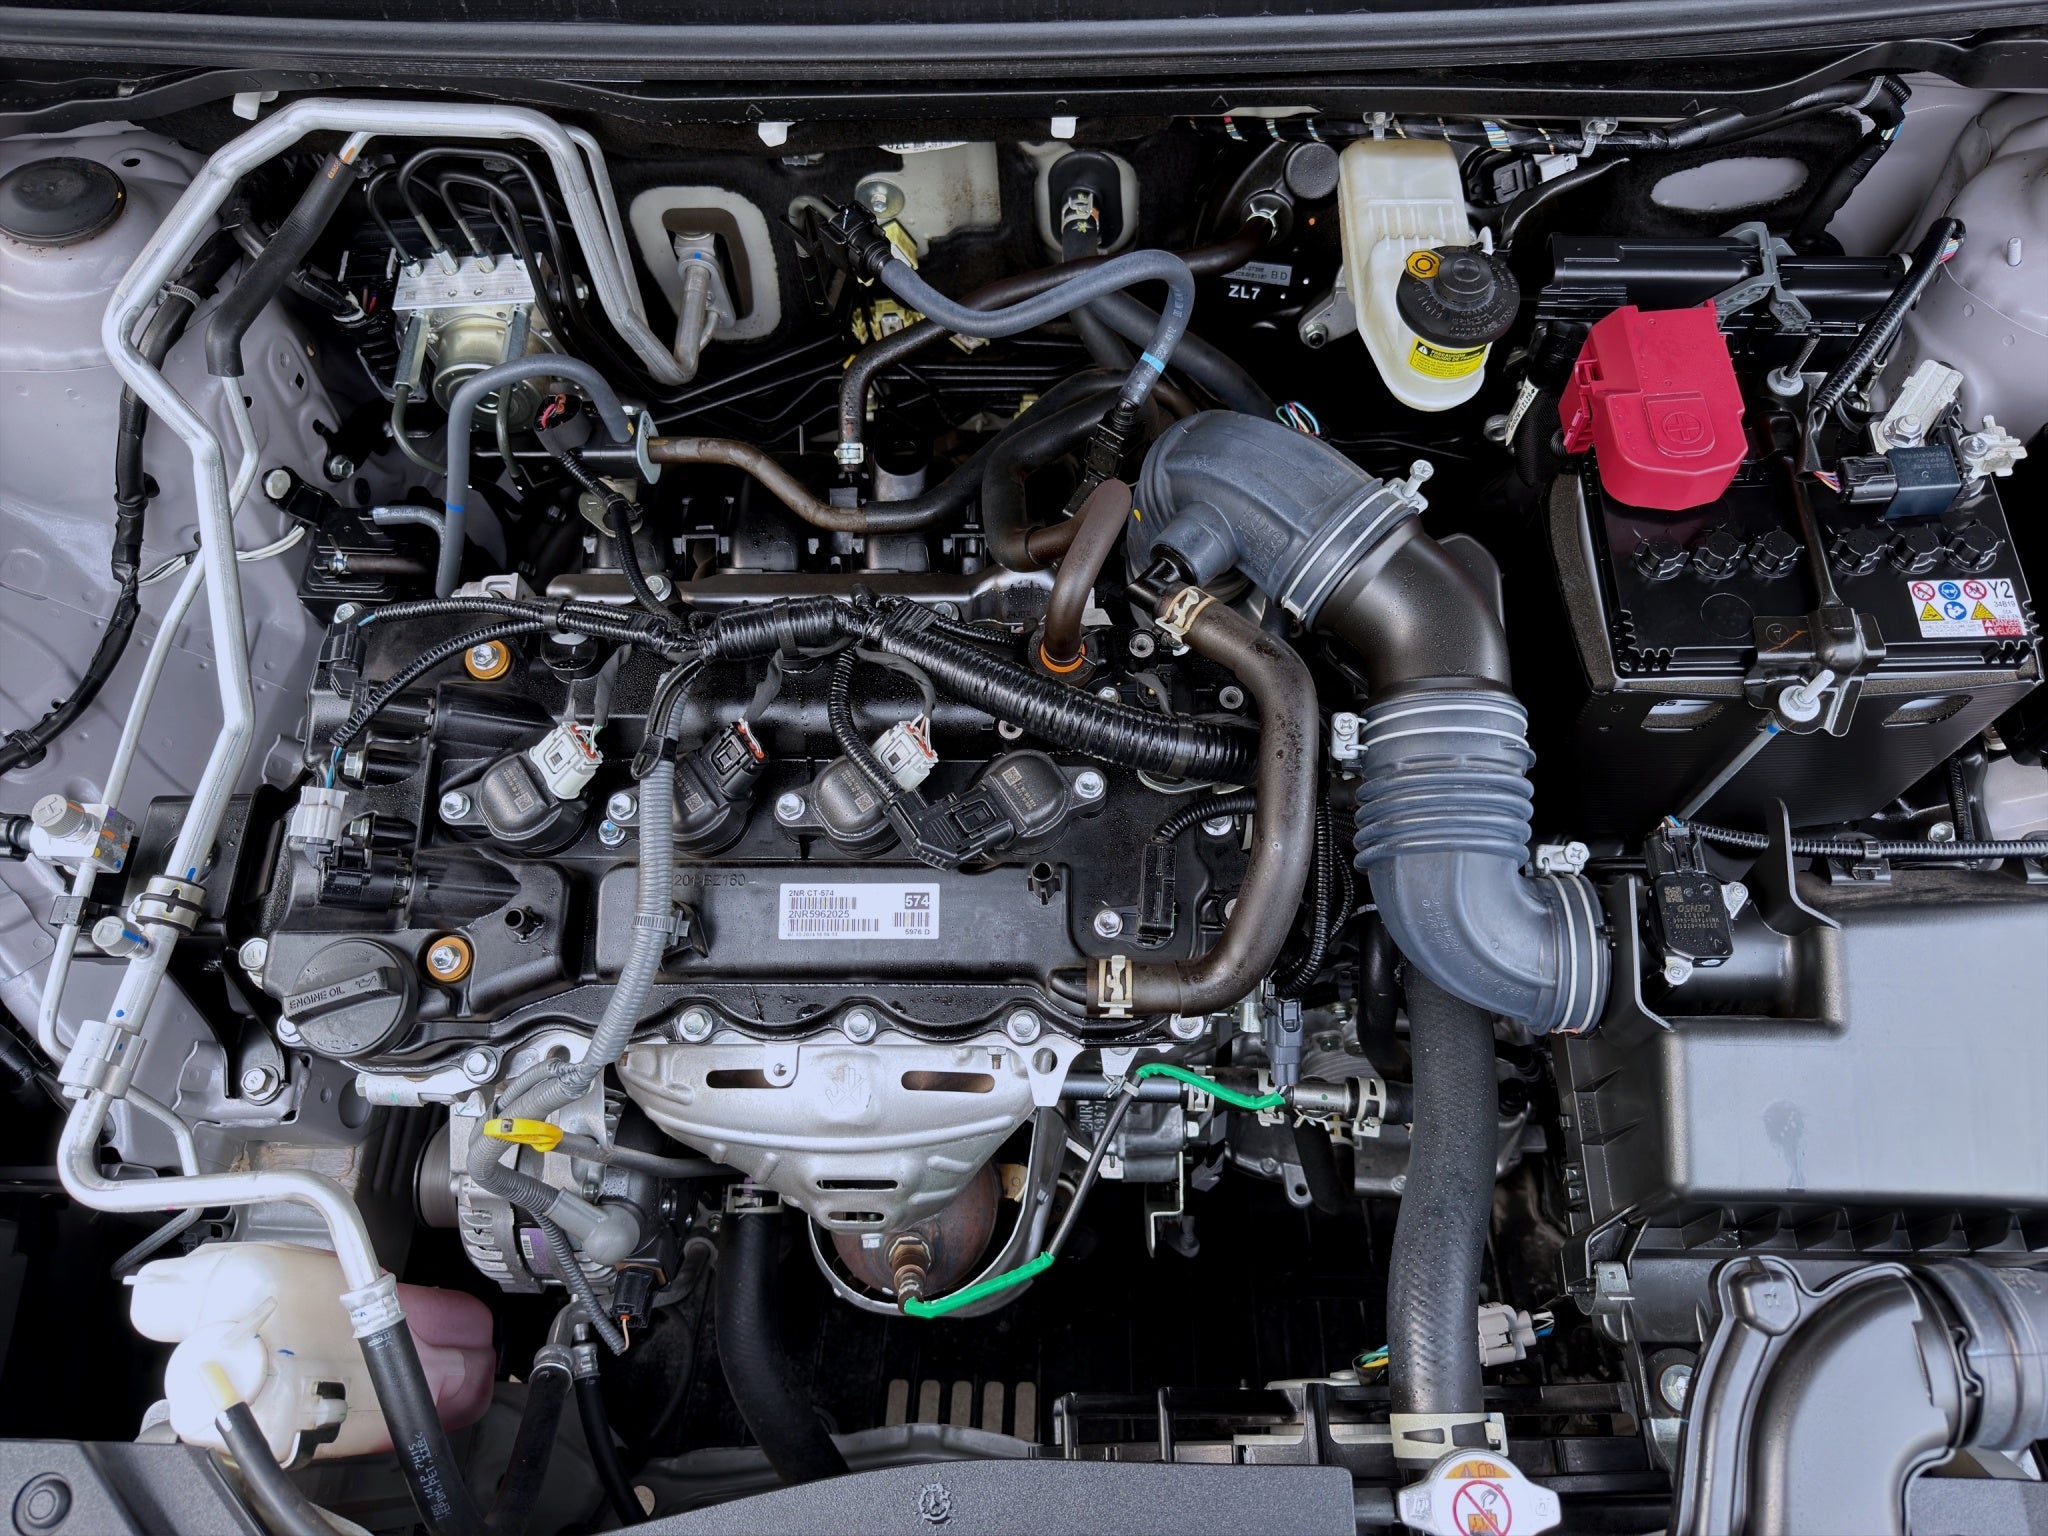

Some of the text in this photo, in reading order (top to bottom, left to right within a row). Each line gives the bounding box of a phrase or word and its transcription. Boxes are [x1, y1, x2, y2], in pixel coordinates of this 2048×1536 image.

[1228, 284, 1261, 300] ZL7
[1987, 580, 2013, 599] Y2
[1994, 627, 2022, 635] PELIGRO
[905, 895, 930, 907] 574
[1677, 904, 1711, 912] DENSO
[788, 910, 850, 918] 2NR5962025
[289, 986, 345, 1010] ENGINE OIL
[1079, 1106, 1093, 1131] 2NR
